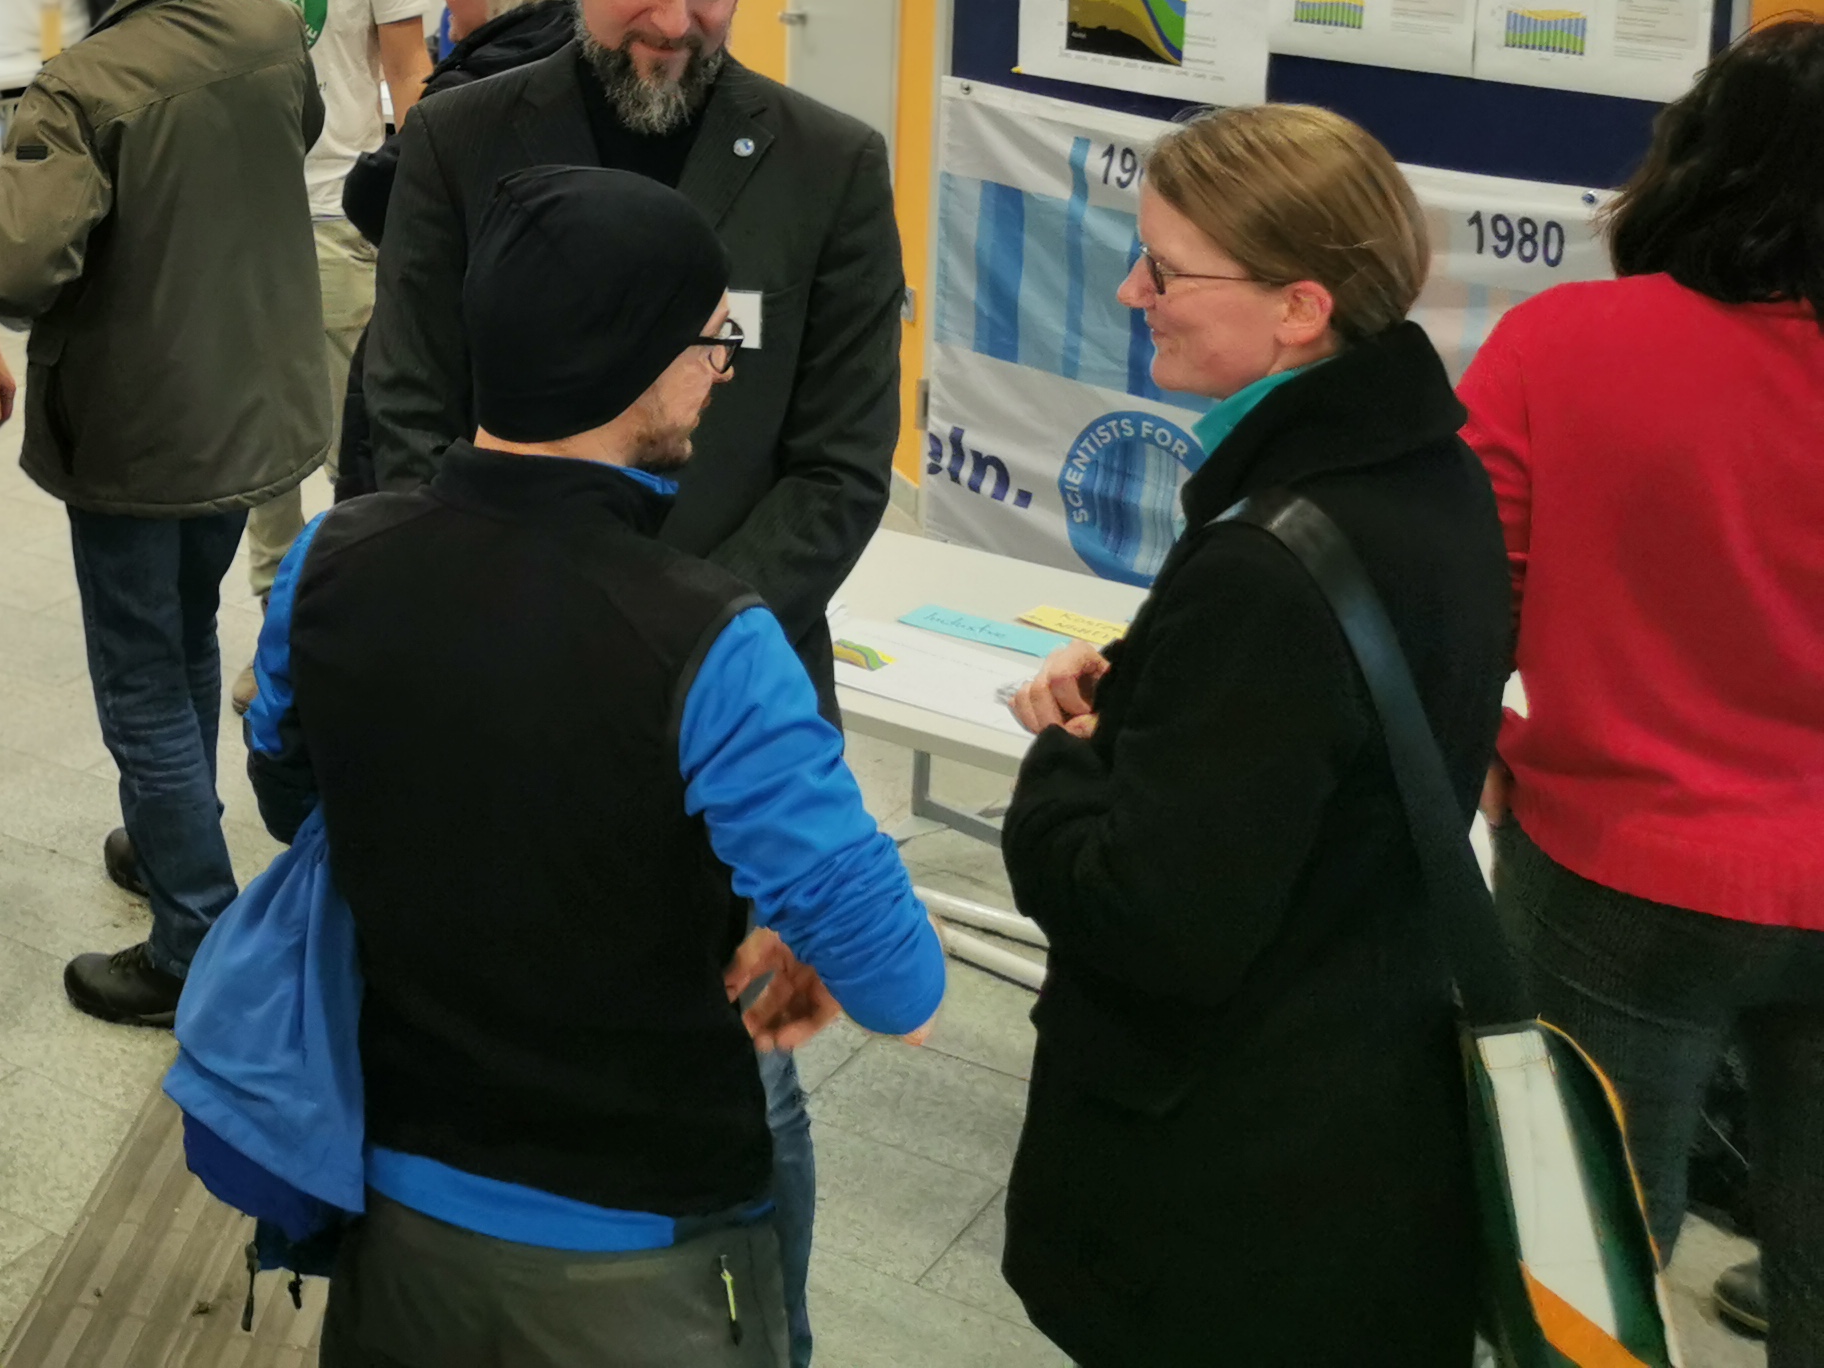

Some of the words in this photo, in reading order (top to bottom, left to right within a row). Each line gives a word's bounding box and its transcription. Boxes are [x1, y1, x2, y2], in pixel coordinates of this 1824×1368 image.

[1100, 143, 1144, 189] 19
[1467, 210, 1565, 268] 1980
[1064, 418, 1135, 524] SCIENTISTS
[1140, 420, 1189, 460] FOR
